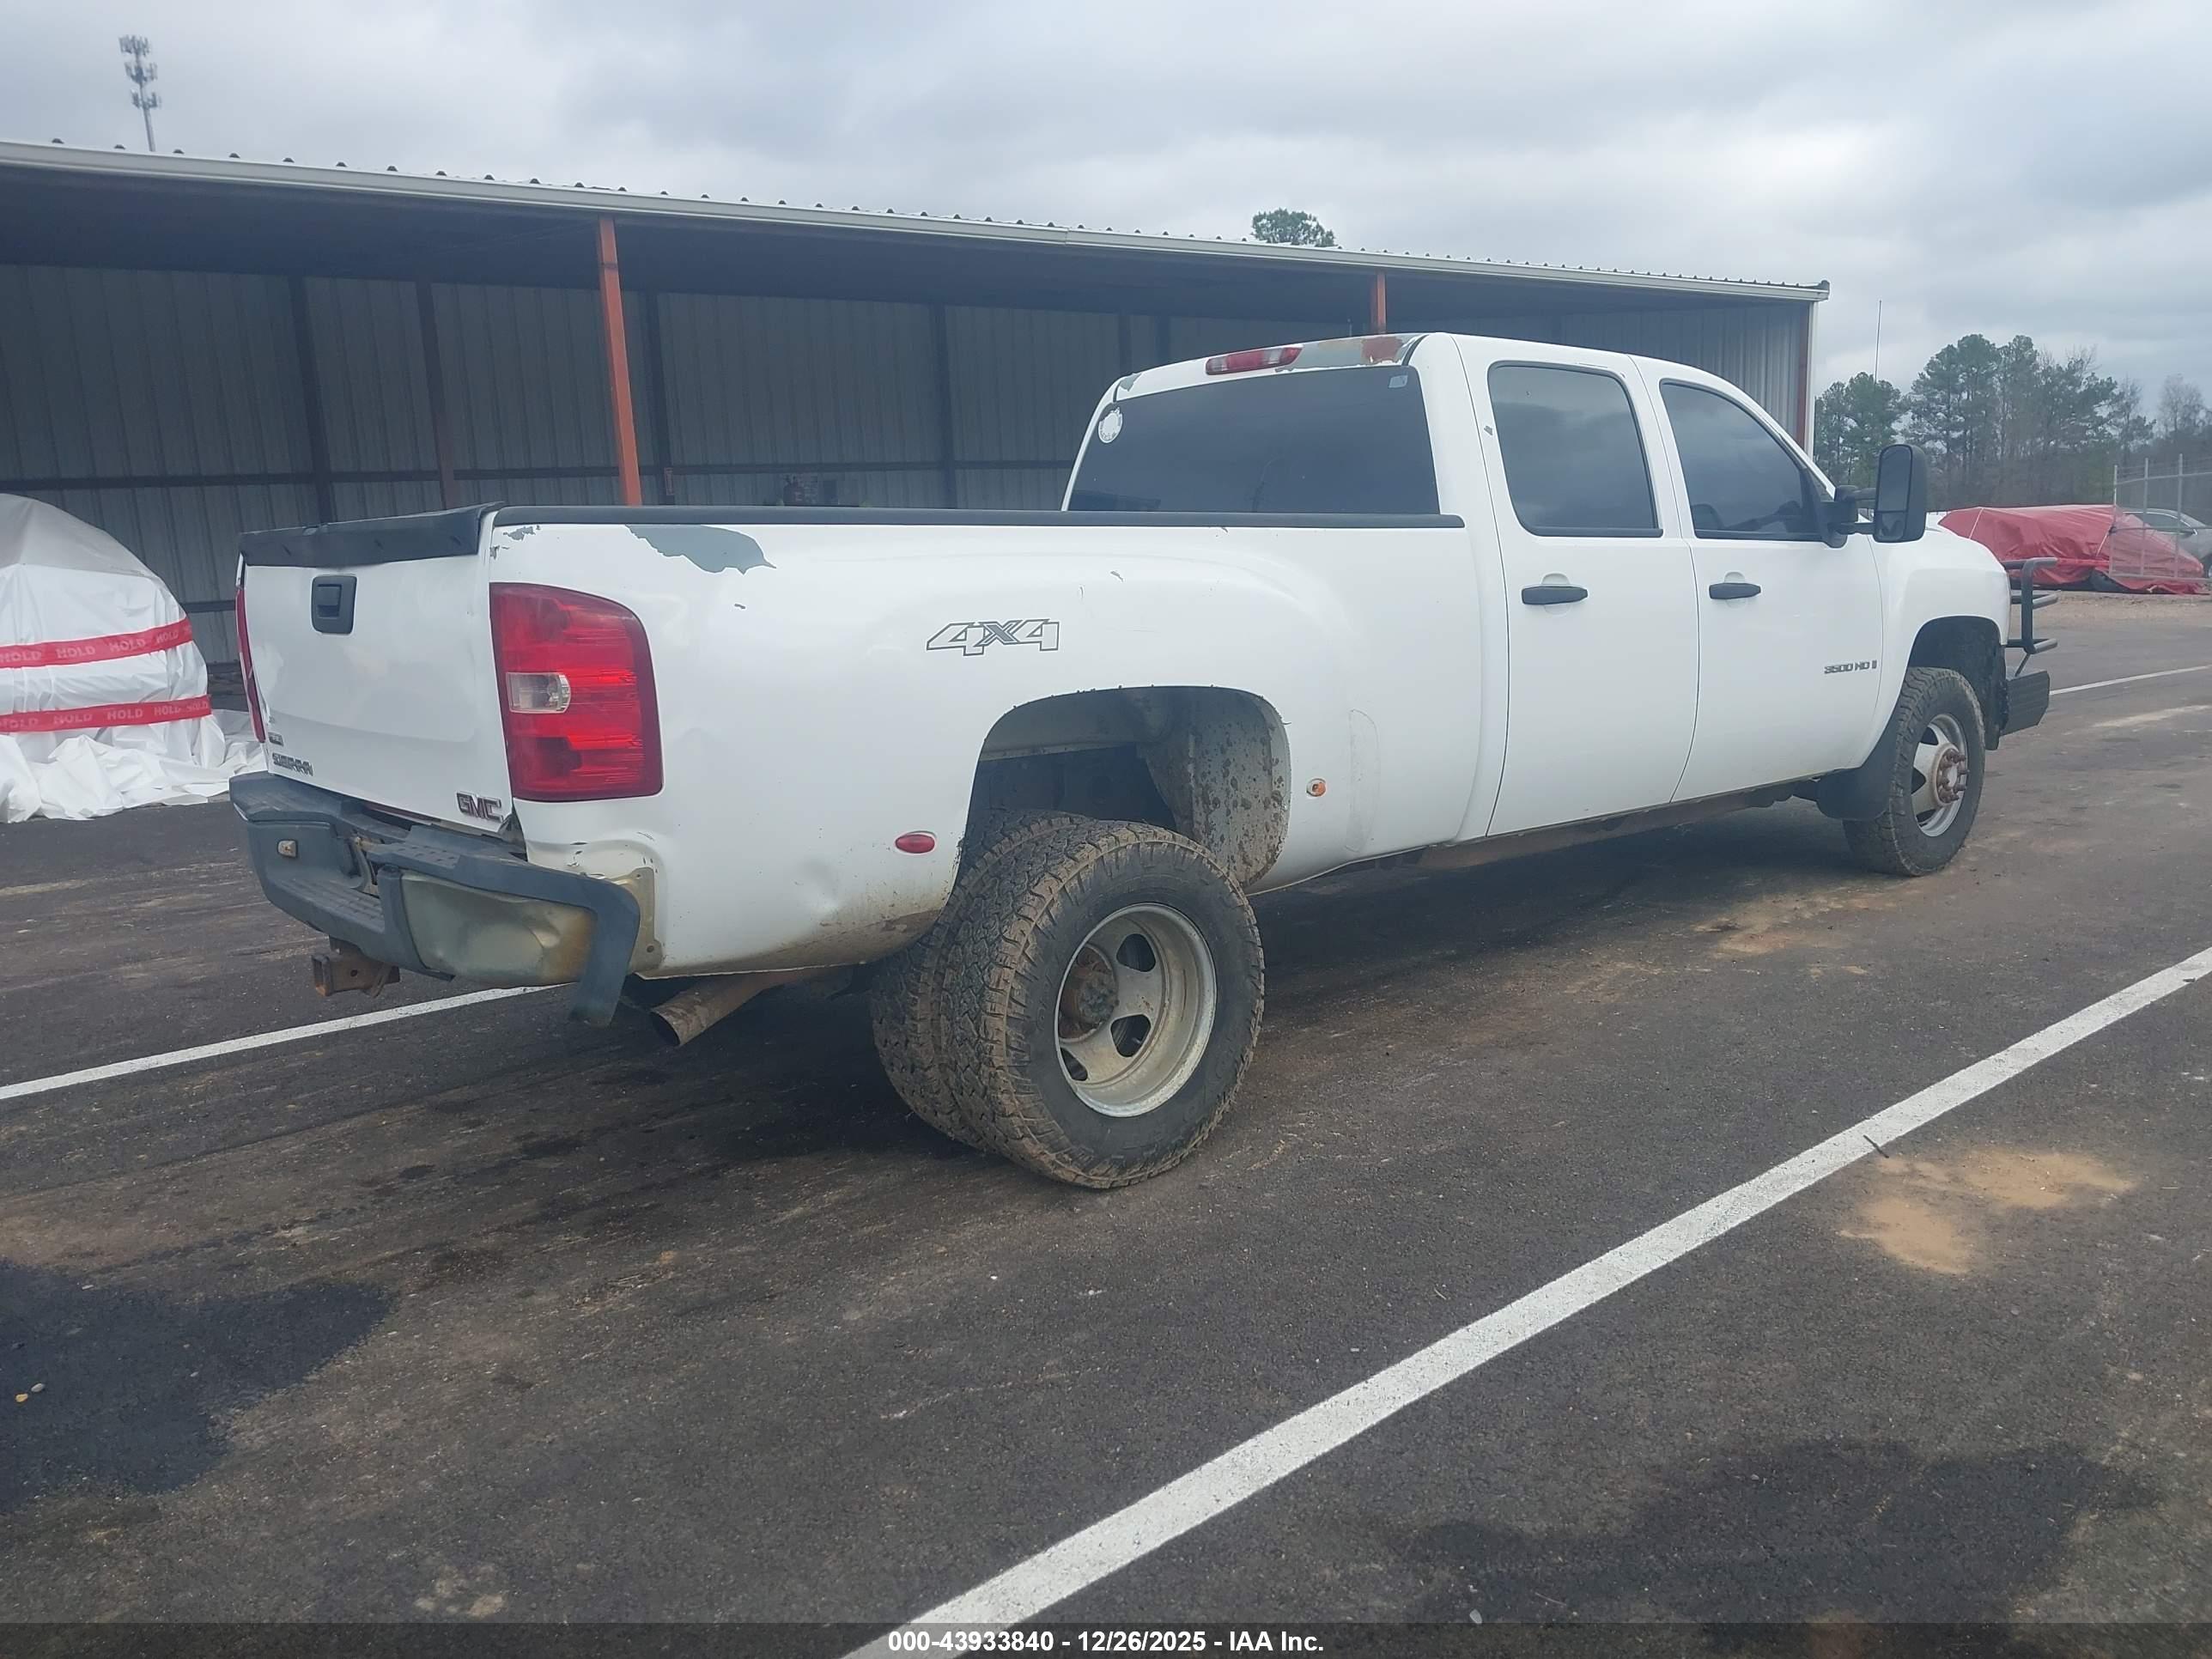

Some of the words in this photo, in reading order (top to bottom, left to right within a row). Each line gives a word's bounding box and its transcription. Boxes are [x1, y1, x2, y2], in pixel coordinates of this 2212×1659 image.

[56, 646, 96, 659] HOLD
[108, 638, 146, 653] HOLD
[156, 630, 179, 644] HOLD
[106, 709, 143, 720] HOLD
[155, 706, 181, 716] HOLD
[455, 791, 504, 823] GMC
